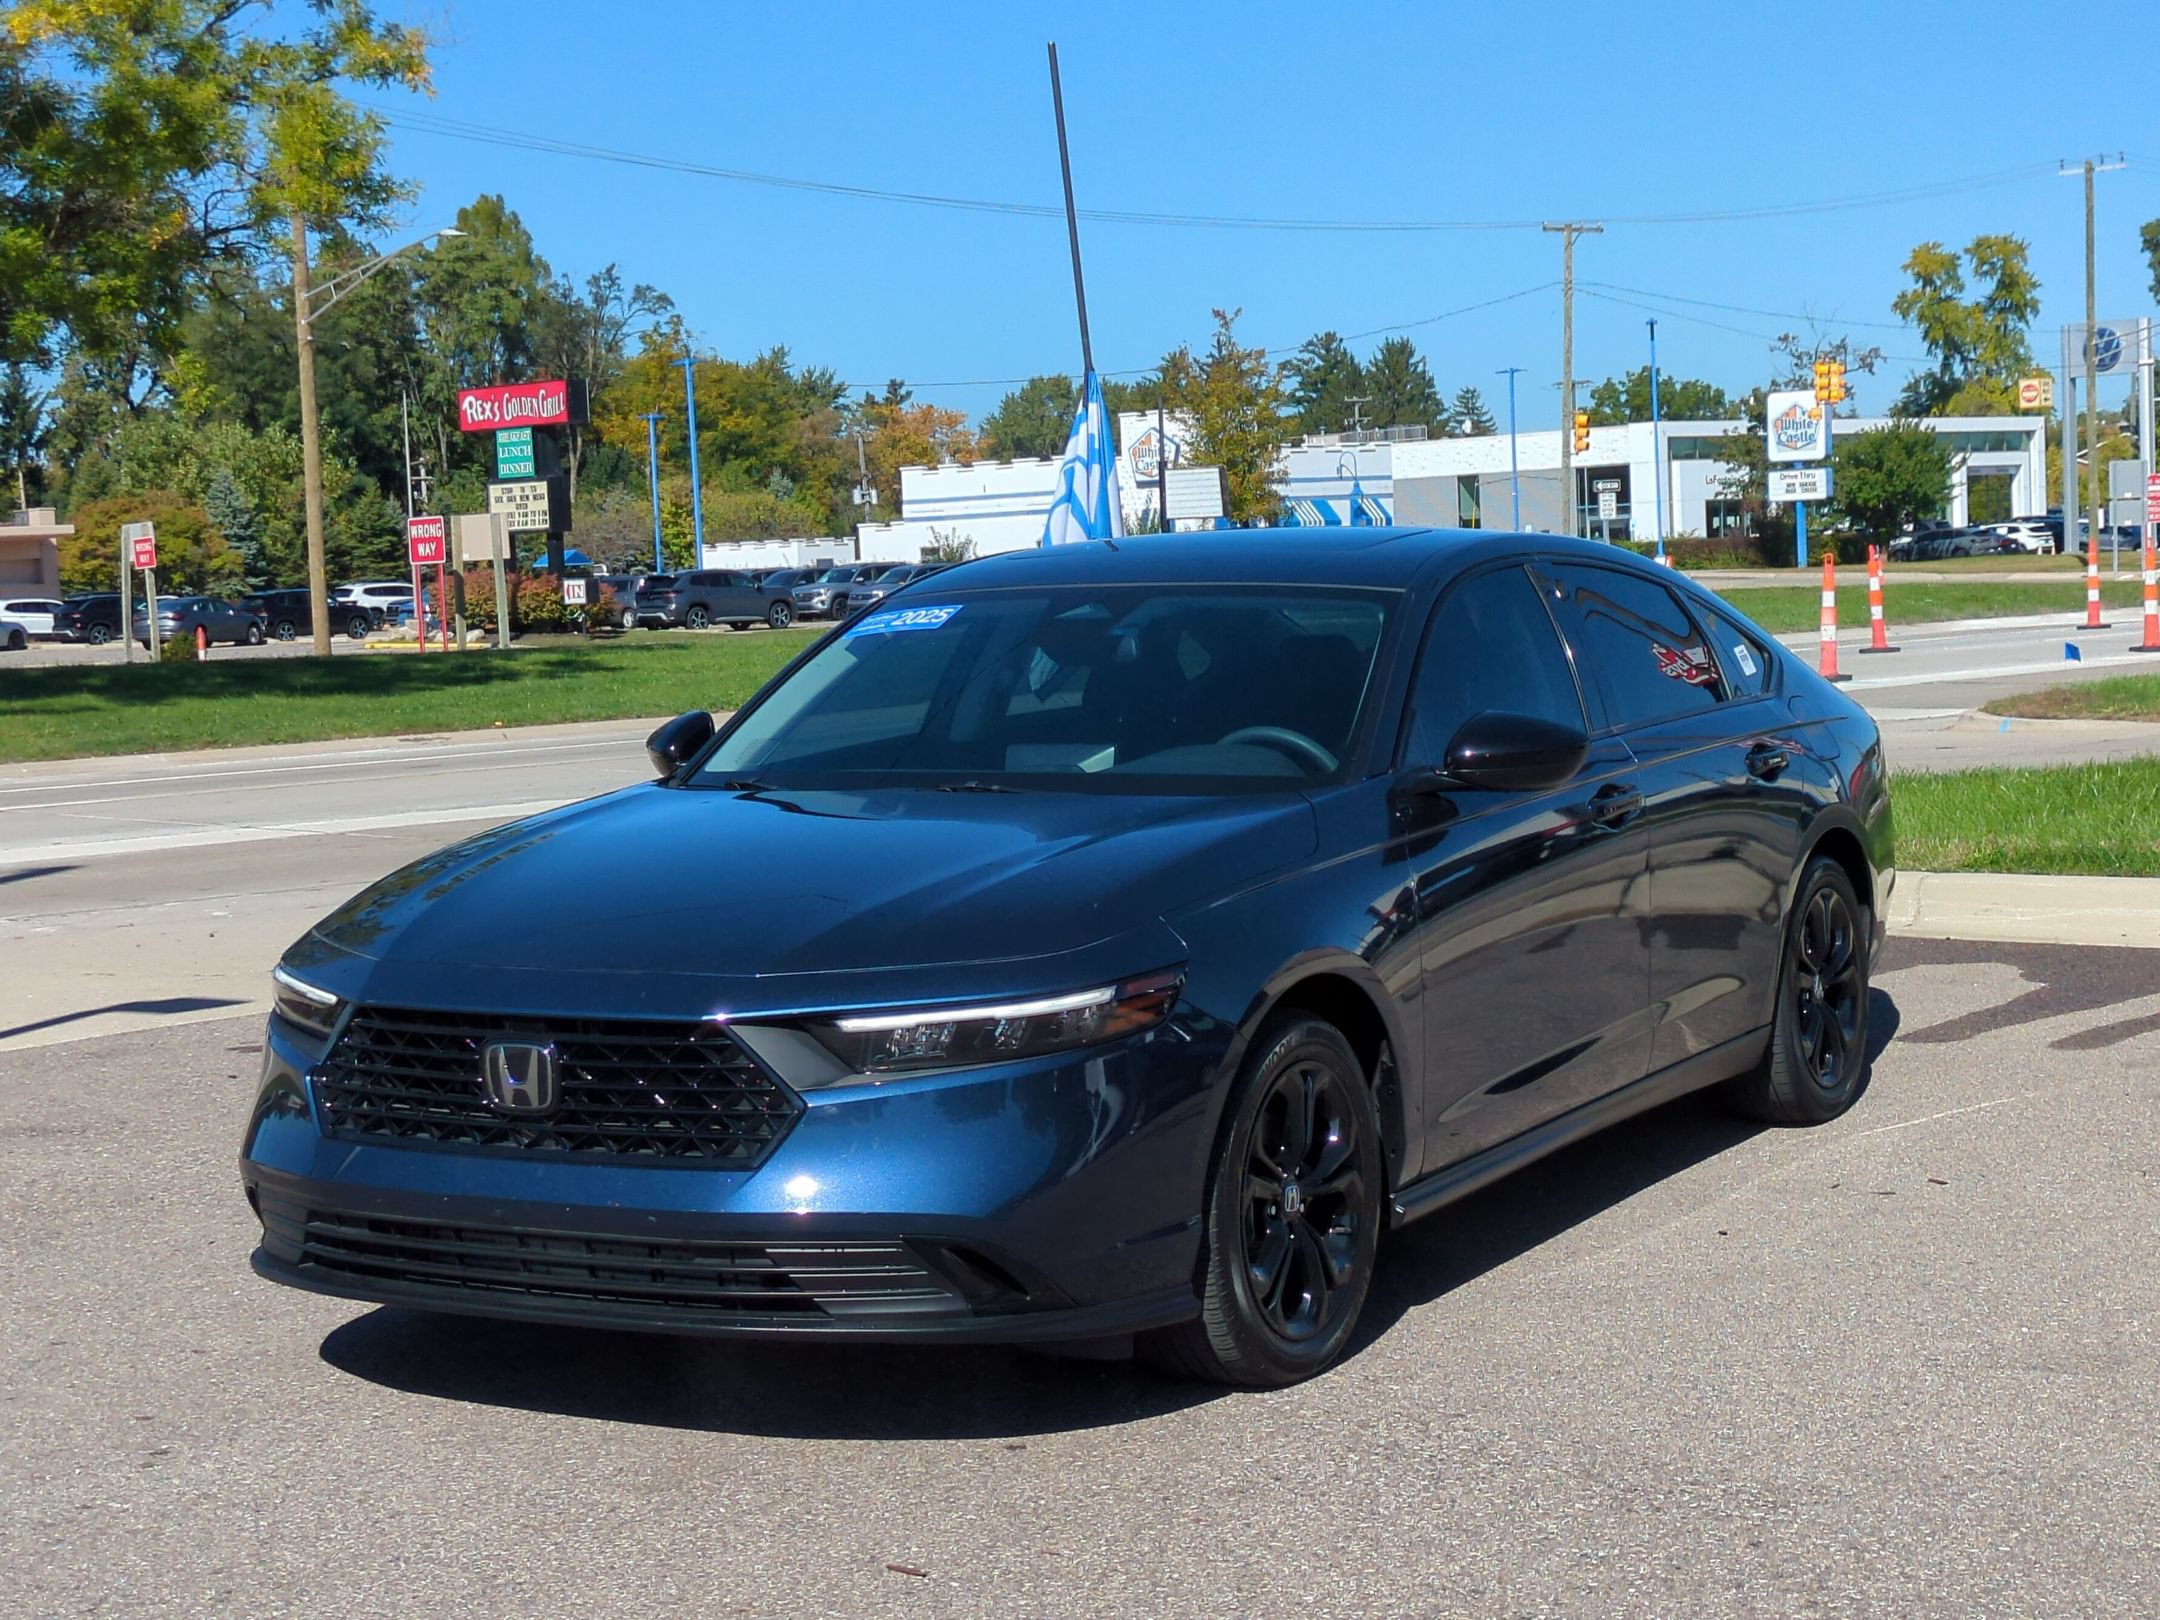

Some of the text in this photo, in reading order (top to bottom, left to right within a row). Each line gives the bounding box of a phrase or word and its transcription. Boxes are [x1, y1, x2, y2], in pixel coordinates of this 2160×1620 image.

[539, 389, 566, 418] GRILL
[1780, 417, 1814, 431] White
[1778, 431, 1816, 443] Castle
[500, 445, 531, 458] LUNCH
[1137, 445, 1159, 460] Whi
[500, 462, 532, 475] DINNER
[1135, 459, 1160, 471] Cast
[411, 523, 442, 538] WRONG
[418, 541, 436, 556] WAY
[572, 584, 585, 598] IN
[890, 608, 954, 625] 2025
